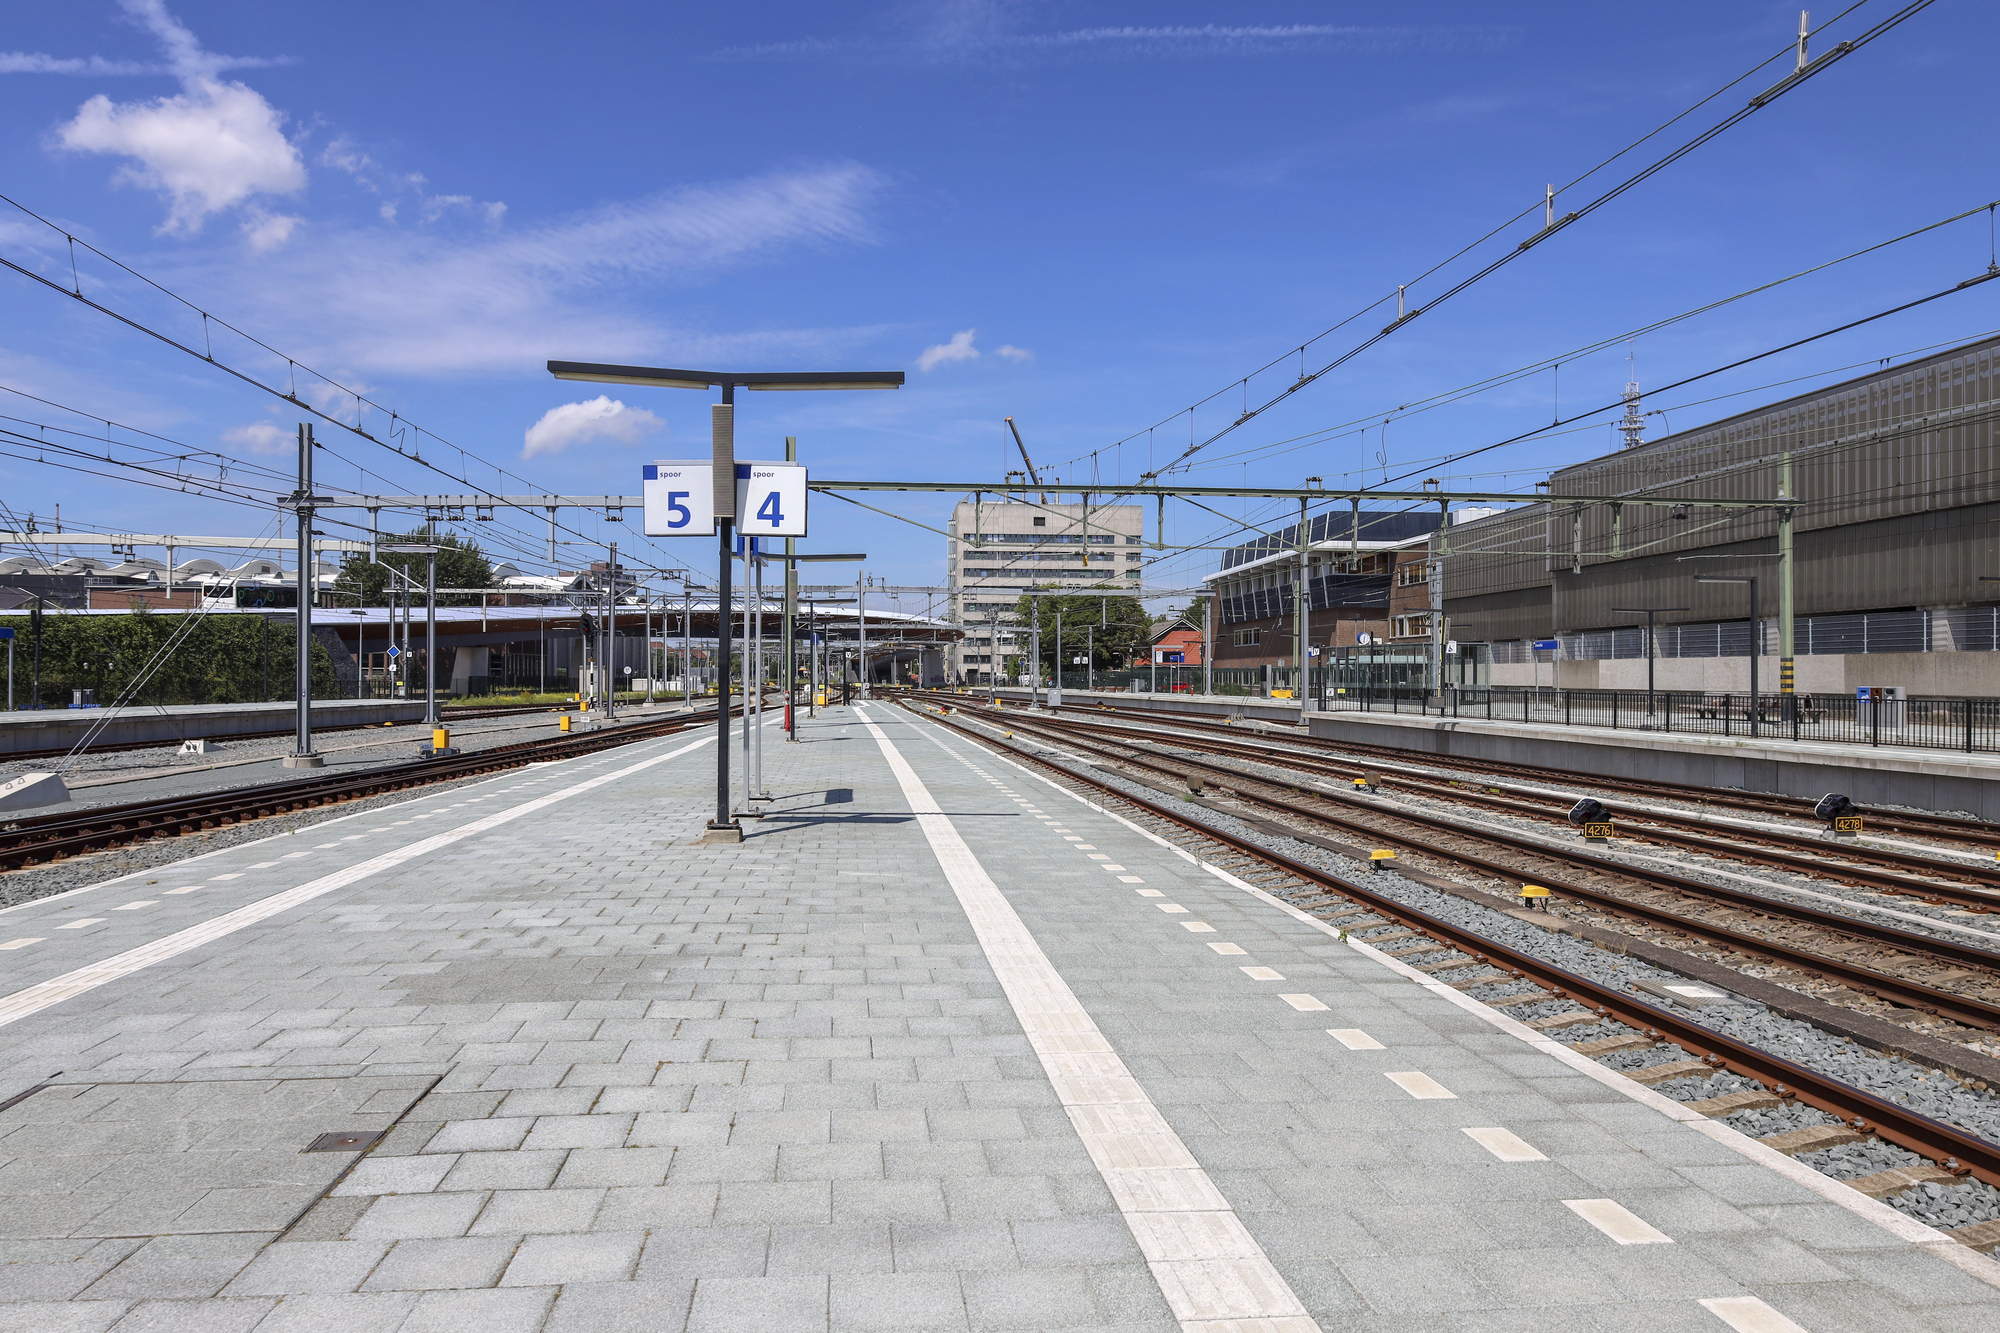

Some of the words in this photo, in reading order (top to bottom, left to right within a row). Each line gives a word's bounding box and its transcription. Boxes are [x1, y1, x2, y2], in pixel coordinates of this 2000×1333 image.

[659, 471, 682, 479] spoor
[752, 471, 775, 479] spoor
[667, 491, 691, 529] 5
[757, 491, 785, 528] 4
[1838, 819, 1860, 829] 4278
[1587, 825, 1611, 836] 4276
